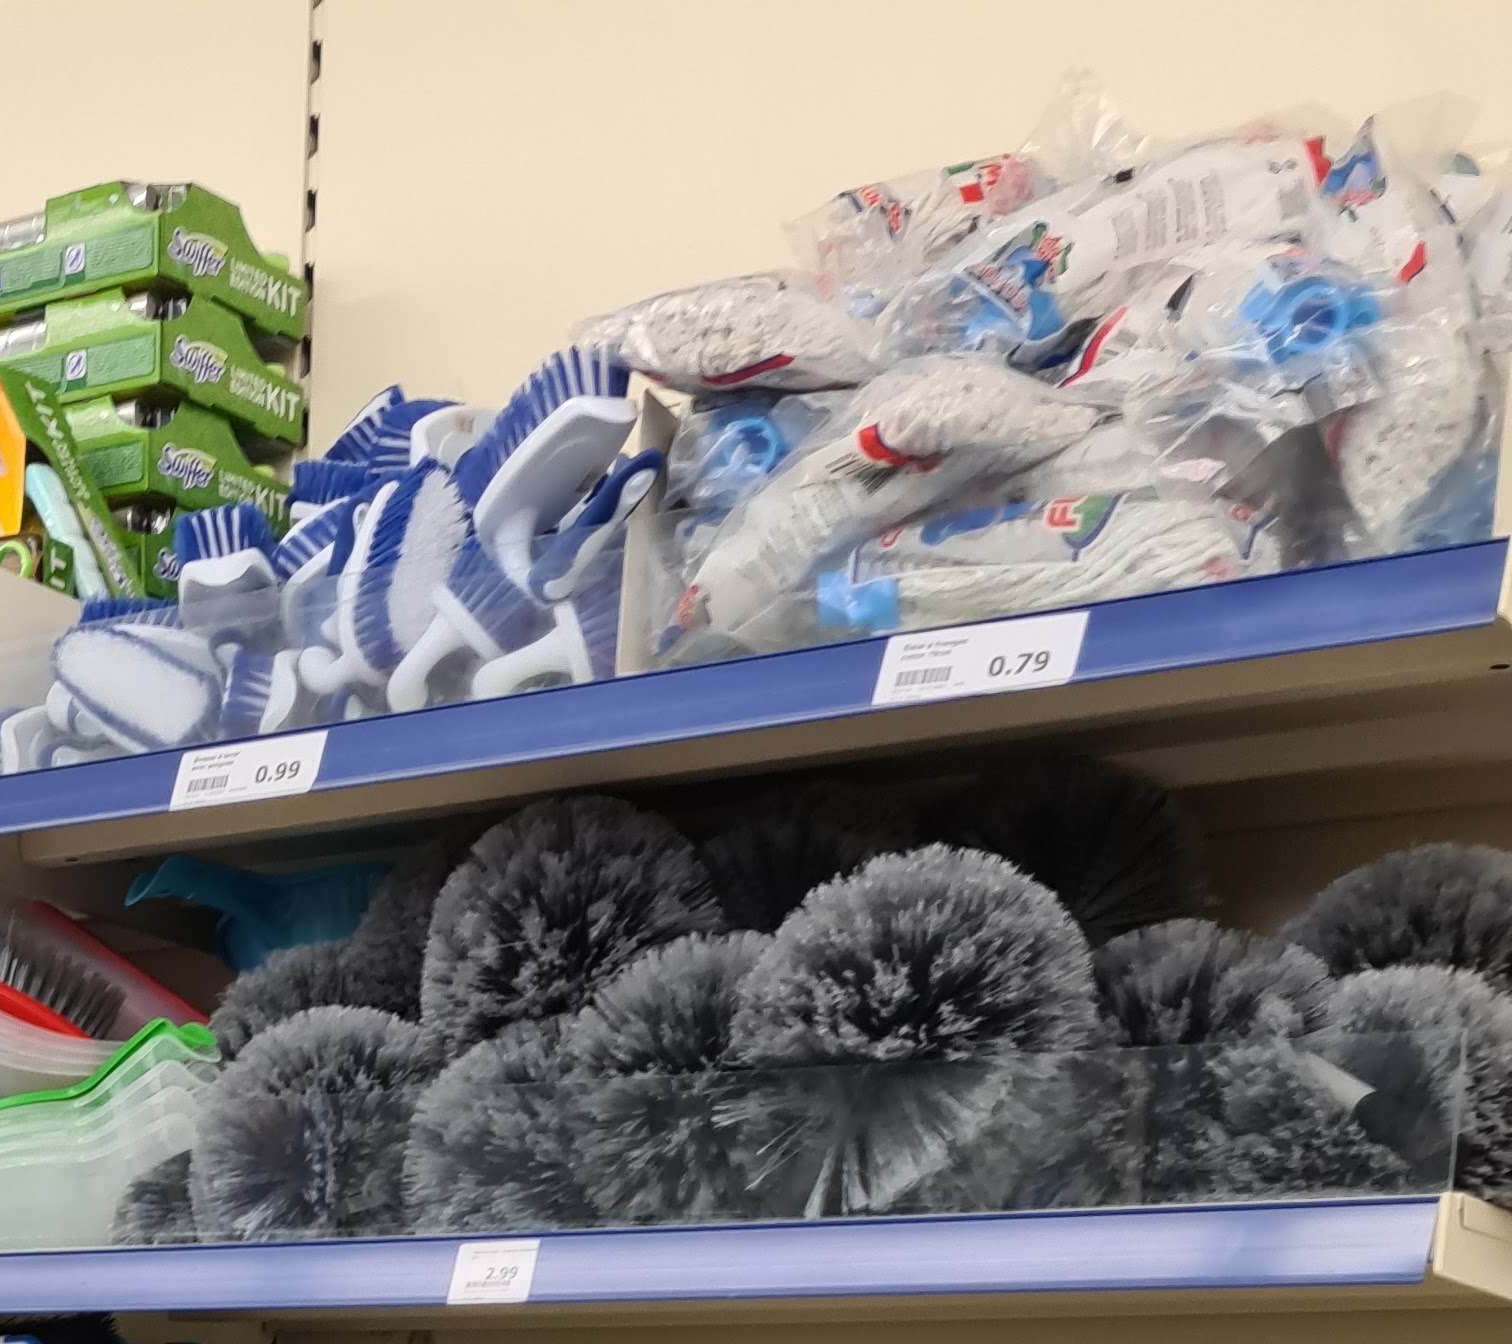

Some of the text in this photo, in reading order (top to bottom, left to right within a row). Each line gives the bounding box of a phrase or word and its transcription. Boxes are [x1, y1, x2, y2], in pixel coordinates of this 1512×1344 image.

[988, 649, 1052, 678] 0.79
[254, 759, 302, 784] 0.99
[485, 1265, 519, 1281] 2.99
